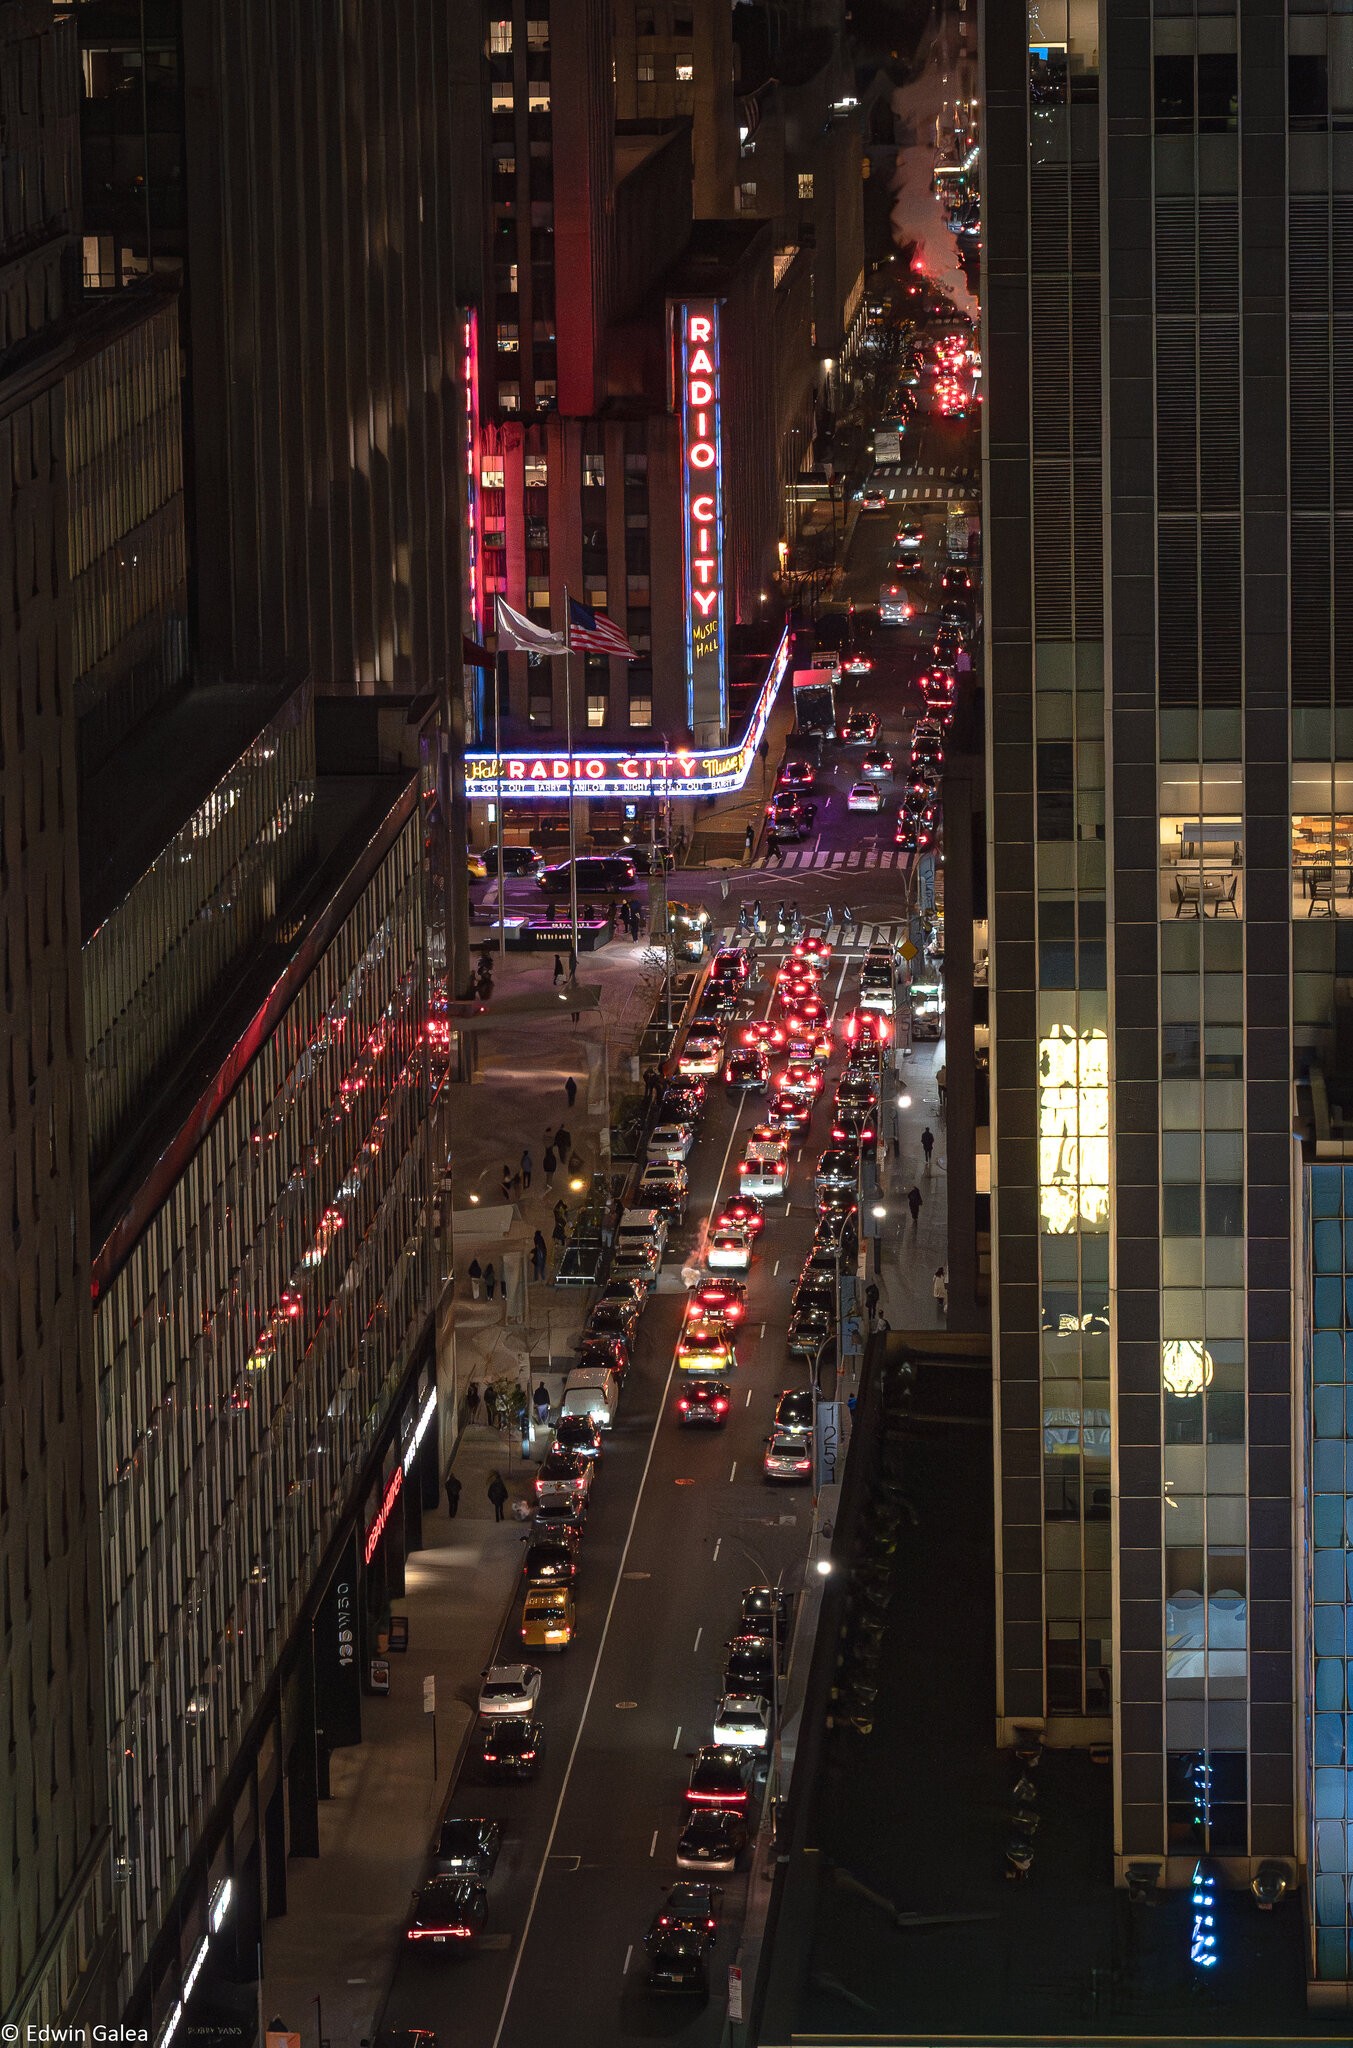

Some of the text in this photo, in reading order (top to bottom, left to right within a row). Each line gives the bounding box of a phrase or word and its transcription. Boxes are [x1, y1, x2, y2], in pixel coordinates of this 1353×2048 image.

[690, 318, 717, 614] RADIO CITY
[693, 620, 718, 640] MUSIC
[696, 639, 719, 659] HALL
[509, 760, 605, 779] RADIO
[622, 759, 696, 778] CITY
[534, 784, 561, 792] BARRY
[713, 1010, 754, 1021] ONLY
[823, 1405, 837, 1485] 1251
